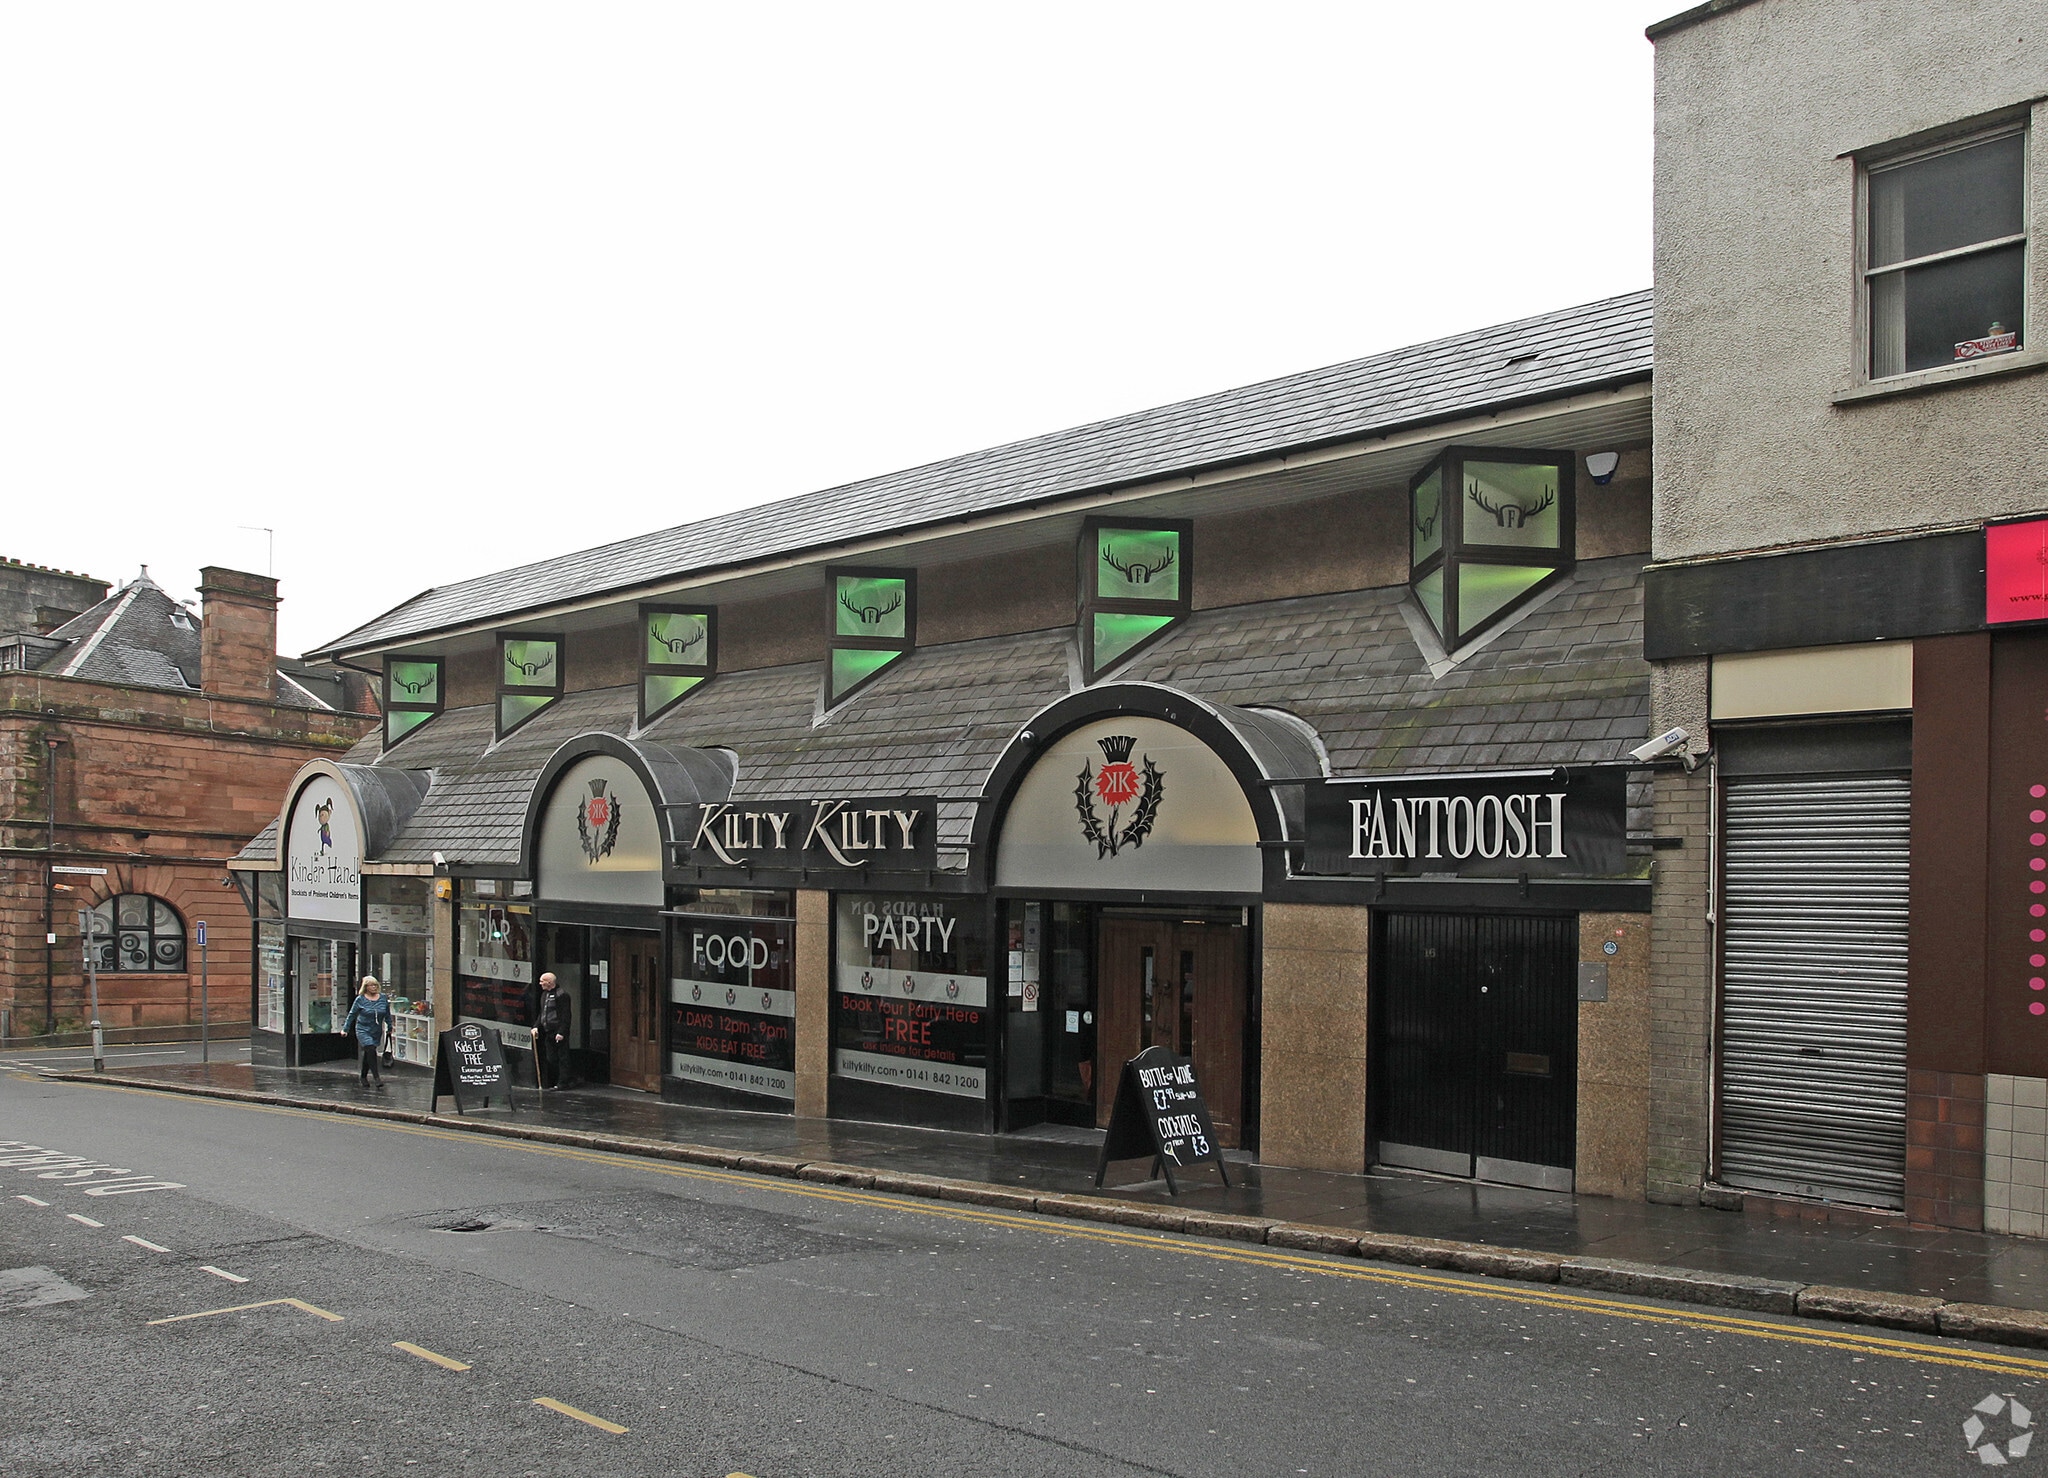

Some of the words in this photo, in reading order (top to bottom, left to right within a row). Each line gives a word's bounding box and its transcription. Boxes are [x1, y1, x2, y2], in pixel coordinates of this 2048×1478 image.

[692, 803, 790, 865] KILTY
[802, 800, 919, 867] KILTY
[1348, 789, 1567, 858] FANTOOSH
[291, 856, 324, 884] Kinder
[479, 918, 510, 946] BAR
[864, 913, 956, 953] PARTY
[693, 933, 768, 970] FOOD
[843, 996, 872, 1013] Book
[876, 1000, 904, 1016] Your
[908, 1002, 942, 1021] Party
[946, 1006, 979, 1024] Here
[677, 1010, 683, 1024] 7
[686, 1011, 714, 1029] DAYS
[720, 1015, 750, 1035] 12pm
[760, 1021, 787, 1039] 9pm
[885, 1018, 932, 1045] FREE
[454, 1040, 472, 1053] Kids
[473, 1040, 487, 1052] Eat
[463, 1053, 484, 1065] FREE
[696, 1035, 718, 1052] KIDS
[721, 1040, 738, 1055] EAT
[741, 1042, 765, 1059] FREE
[862, 1041, 877, 1050] ask
[880, 1043, 906, 1055] inside
[909, 1045, 921, 1056] for
[924, 1047, 956, 1062] details
[680, 1062, 723, 1078] kiltykilty.com
[729, 1071, 747, 1083] 0141
[750, 1075, 764, 1086] 842
[767, 1077, 786, 1089] 1200
[842, 1060, 898, 1077] kiltykilty.com
[906, 1068, 929, 1081] 0141
[932, 1072, 950, 1084] 842
[954, 1075, 979, 1089] 1200
[1139, 1067, 1170, 1088] BOTTLE
[1172, 1064, 1195, 1085] WINE
[1191, 1135, 1210, 1156] £3
